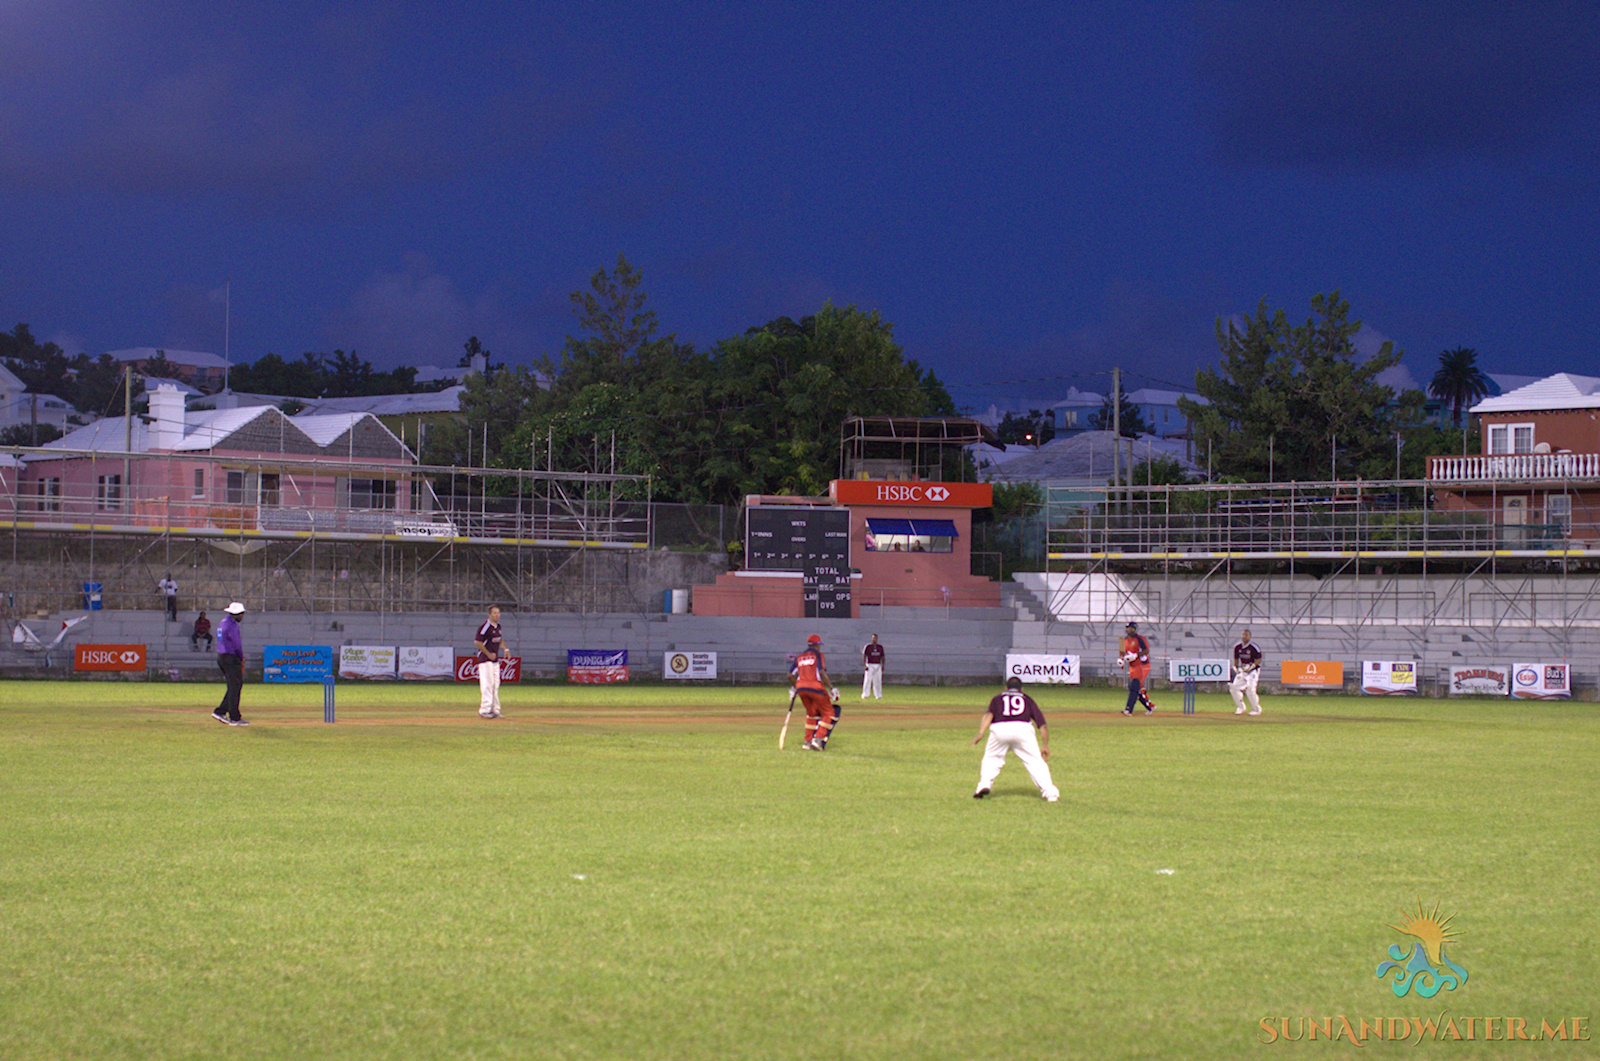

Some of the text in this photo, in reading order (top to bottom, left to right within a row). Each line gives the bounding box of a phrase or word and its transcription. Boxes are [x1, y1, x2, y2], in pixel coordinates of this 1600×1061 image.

[877, 485, 922, 501] HSBC
[82, 650, 118, 664] HSBC
[1012, 664, 1070, 676] GARMIN
[1178, 664, 1223, 676] BELCO
[1546, 668, 1564, 678] Bud's
[1002, 695, 1026, 716] 19
